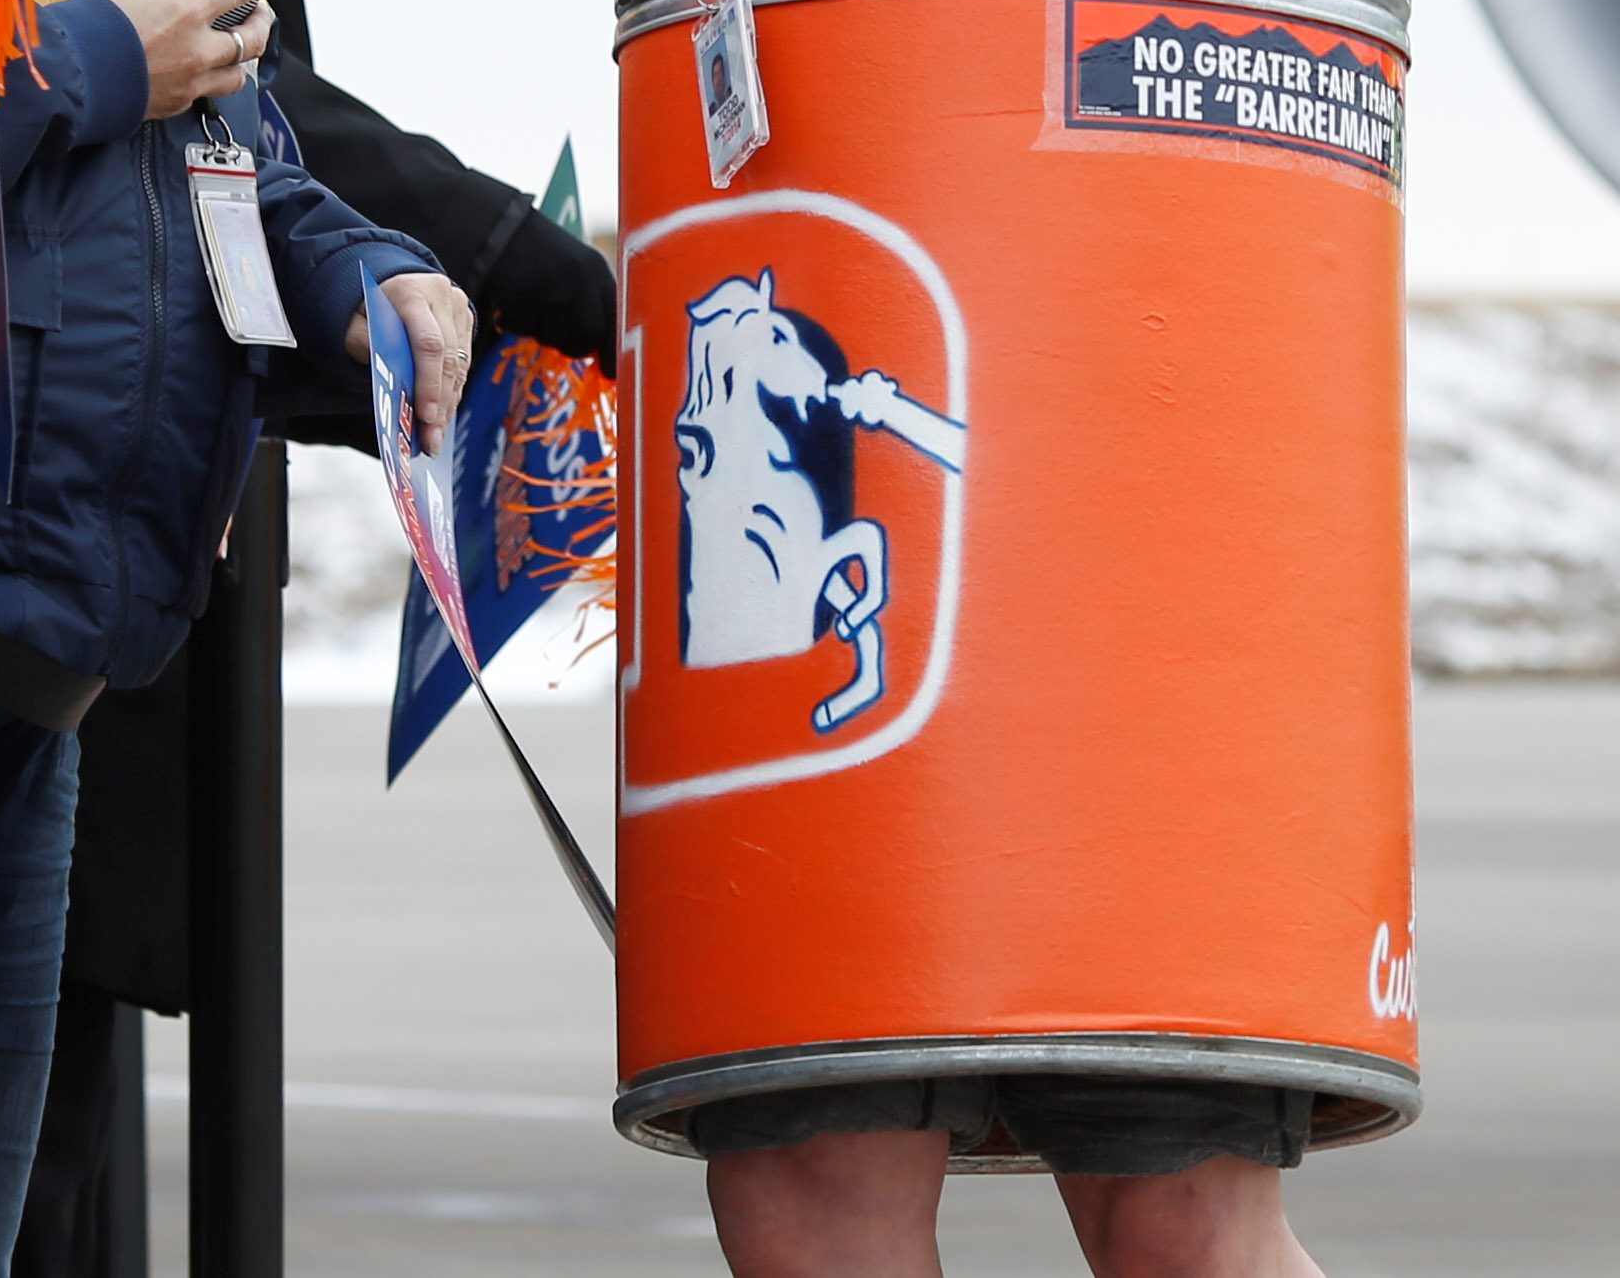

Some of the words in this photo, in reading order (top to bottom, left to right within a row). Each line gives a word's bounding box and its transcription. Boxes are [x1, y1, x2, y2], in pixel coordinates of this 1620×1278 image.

[1131, 75, 1205, 121] THE
[1133, 35, 1184, 73] NO
[1193, 41, 1313, 95] GREATER
[1317, 61, 1356, 105] FAN
[1360, 74, 1395, 123] THAN
